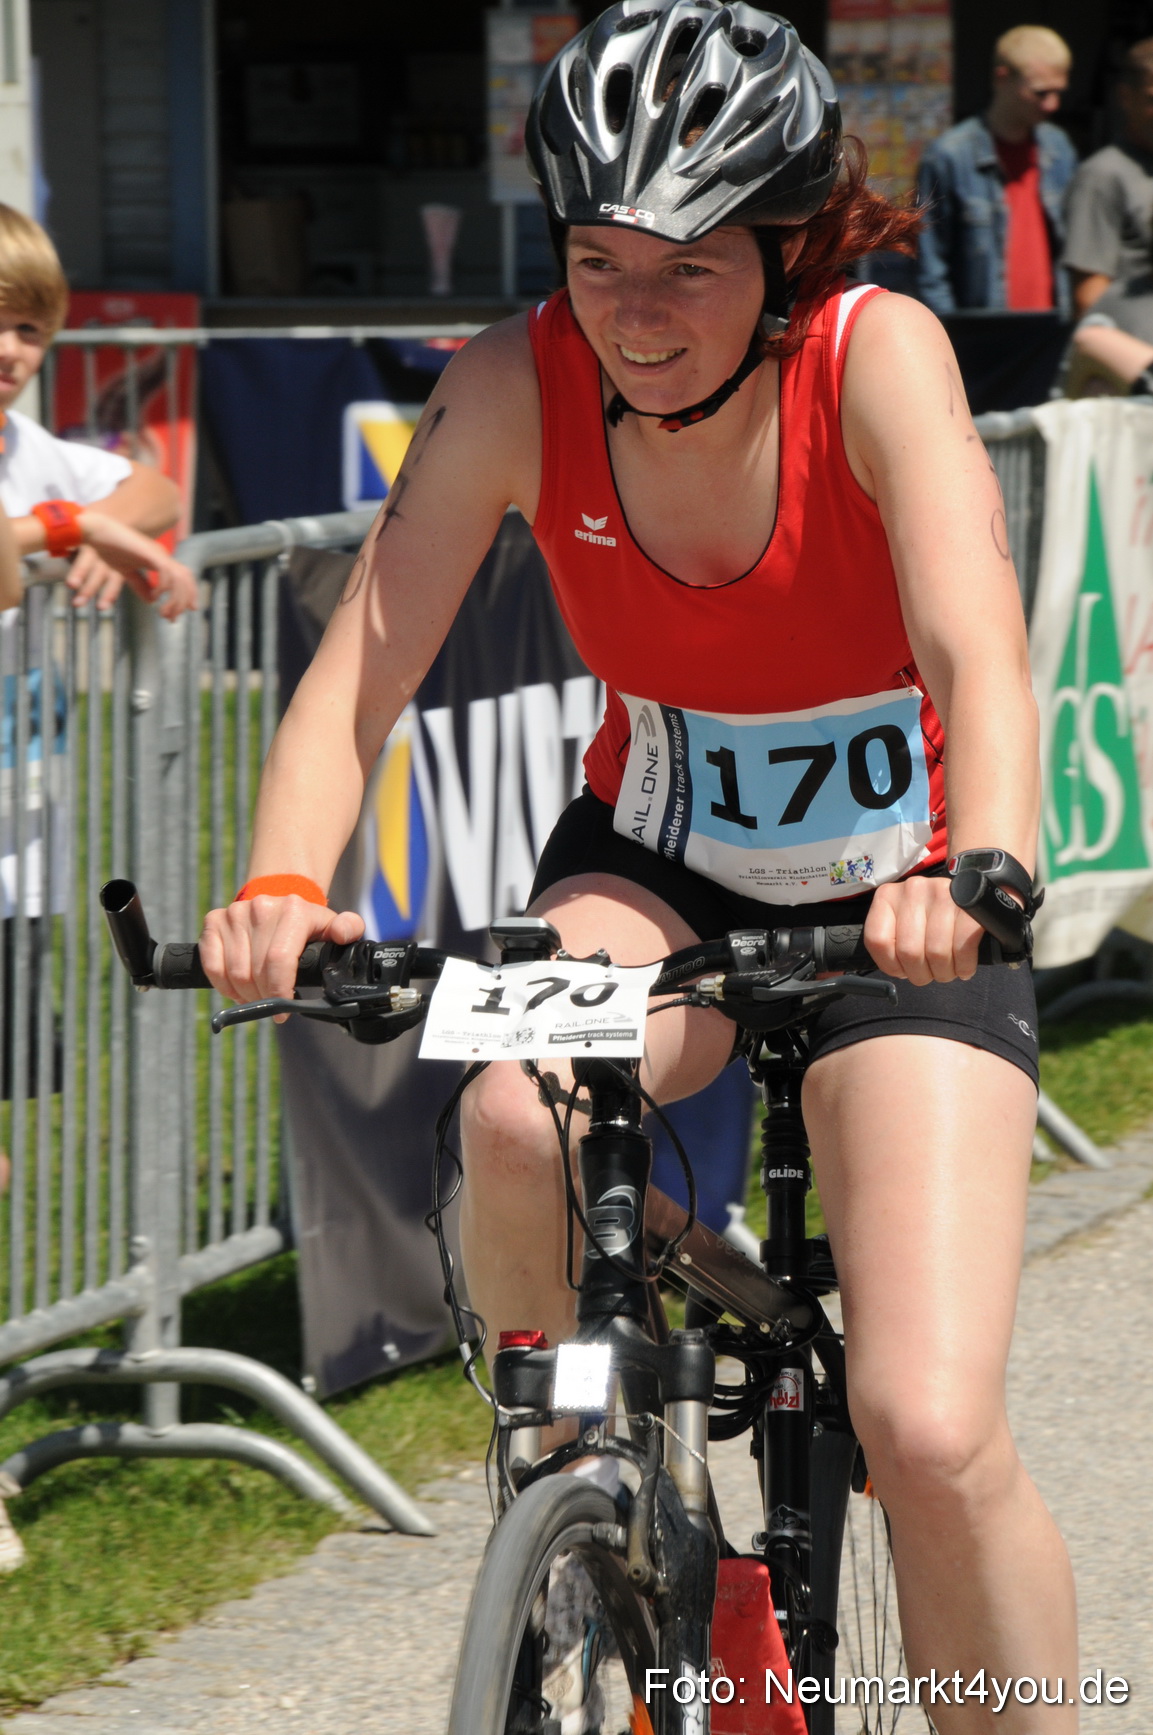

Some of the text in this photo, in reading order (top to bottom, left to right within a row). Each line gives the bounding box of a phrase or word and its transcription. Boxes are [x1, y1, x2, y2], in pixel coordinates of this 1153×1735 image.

[574, 529, 617, 547] erima
[668, 712, 685, 760] systems
[674, 762, 686, 793] track
[706, 724, 913, 830] 170
[776, 866, 827, 874] Triathlon
[731, 939, 766, 948] Deore
[373, 950, 406, 959] Deore
[471, 976, 619, 1016] 170
[552, 1033, 587, 1042] Pfleiderer
[768, 1164, 804, 1179] GLIDE
